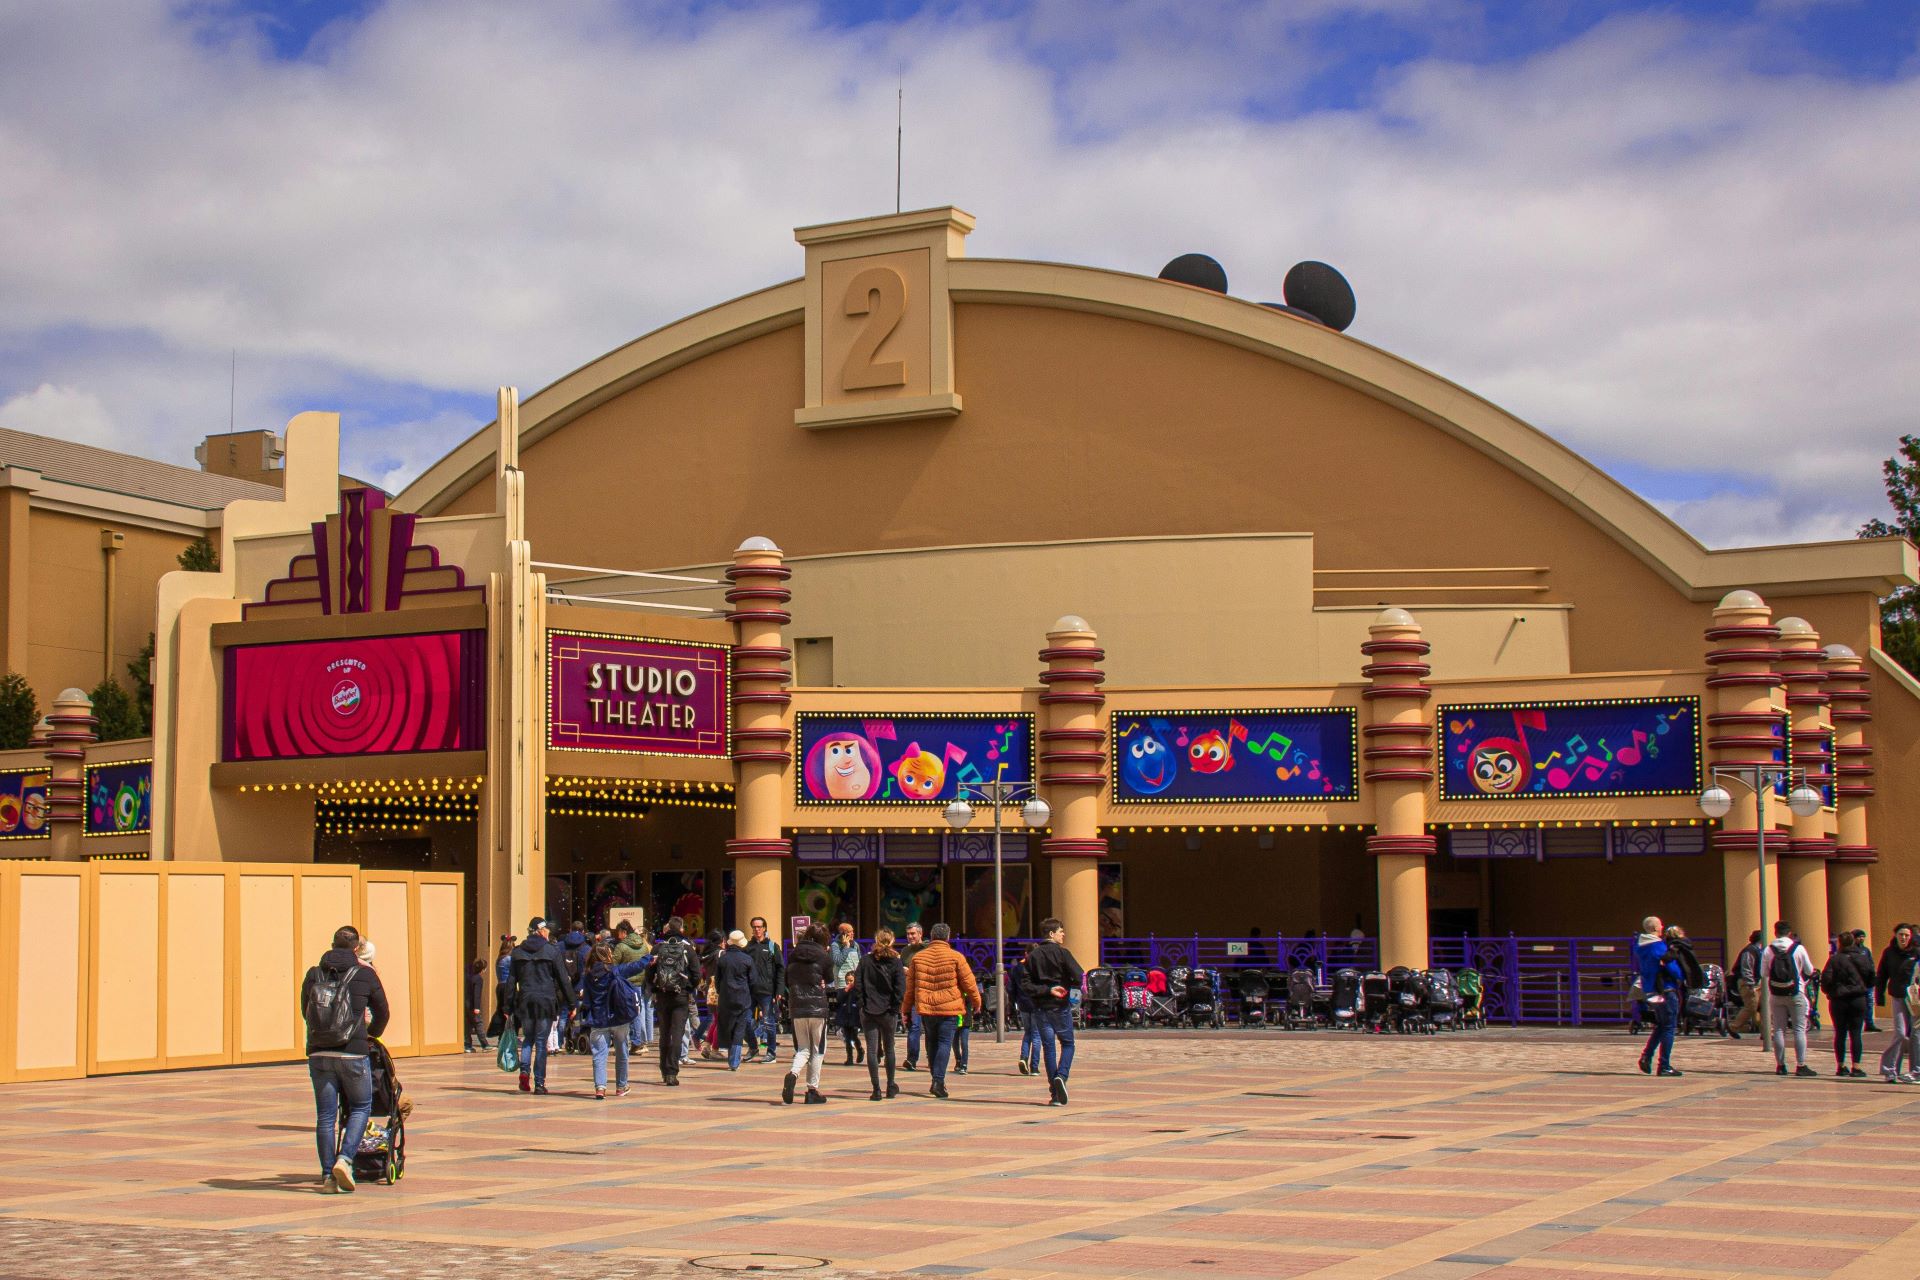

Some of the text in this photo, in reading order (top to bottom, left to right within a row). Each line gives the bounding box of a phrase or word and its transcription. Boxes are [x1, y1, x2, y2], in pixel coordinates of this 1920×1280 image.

[843, 266, 908, 392] 2
[326, 658, 367, 673] PRESENTED
[590, 662, 697, 696] STUDIO
[590, 698, 696, 729] THEATER
